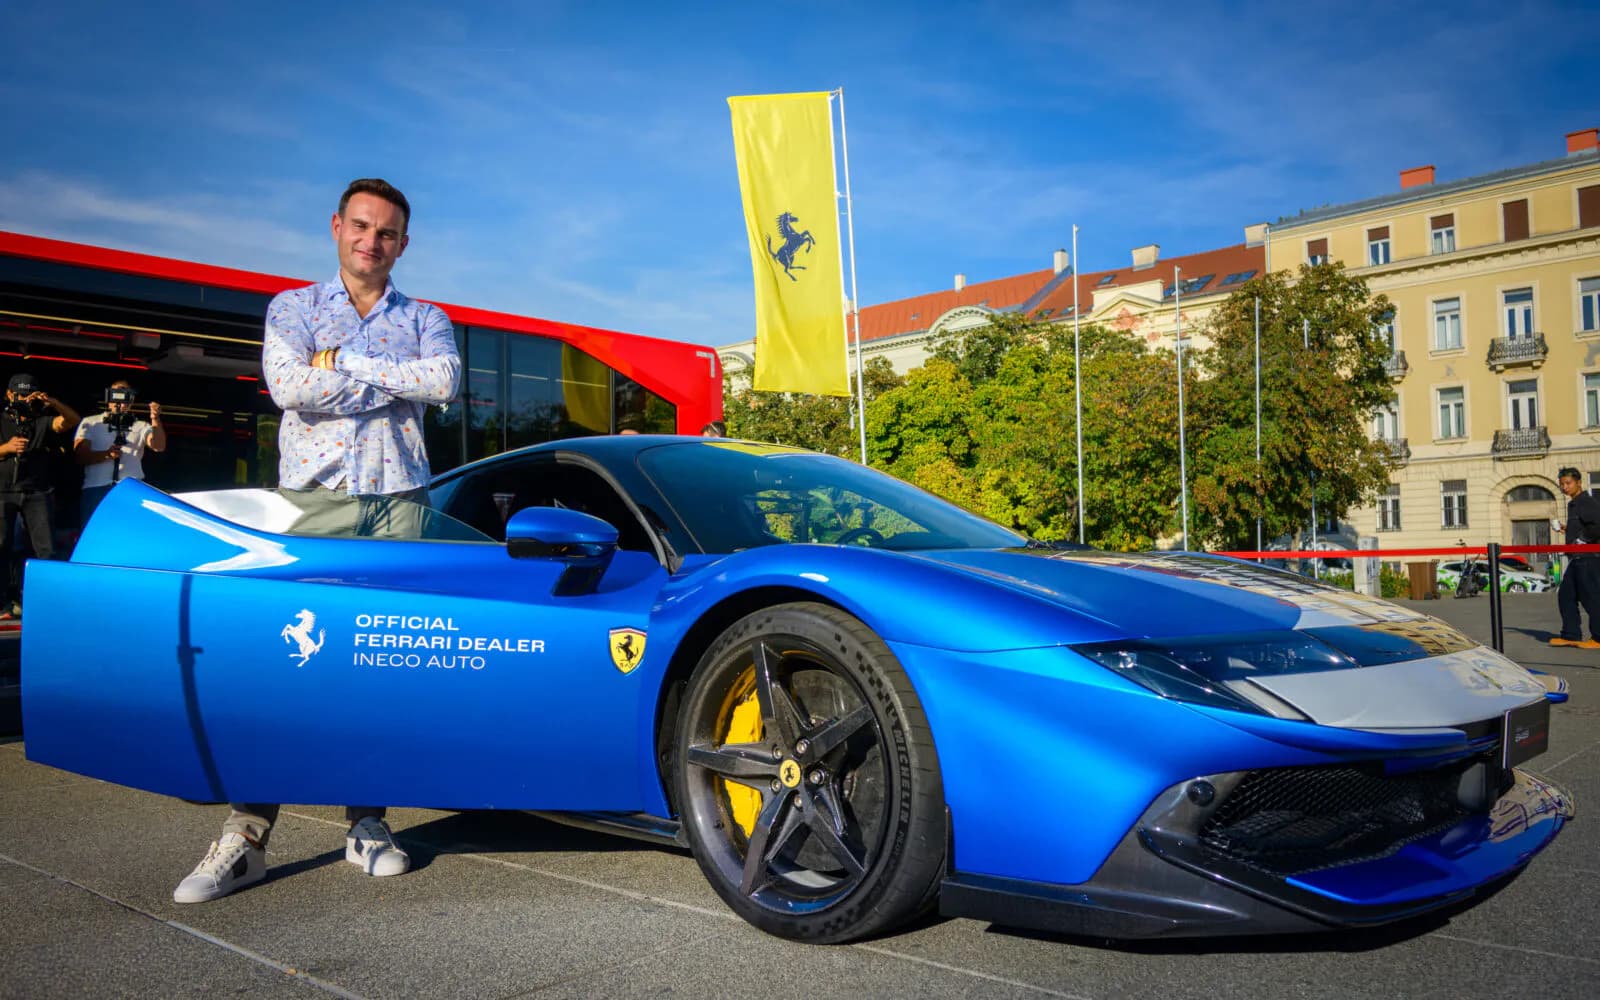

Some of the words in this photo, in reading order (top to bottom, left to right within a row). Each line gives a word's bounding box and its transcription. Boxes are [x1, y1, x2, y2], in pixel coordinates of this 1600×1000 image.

[355, 614, 460, 631] OFFICIAL
[354, 633, 451, 650] FERRARI
[458, 636, 546, 653] DEALER
[353, 652, 421, 668] INECO
[426, 655, 486, 670] AUTO
[892, 728, 912, 824] MICHELIN
